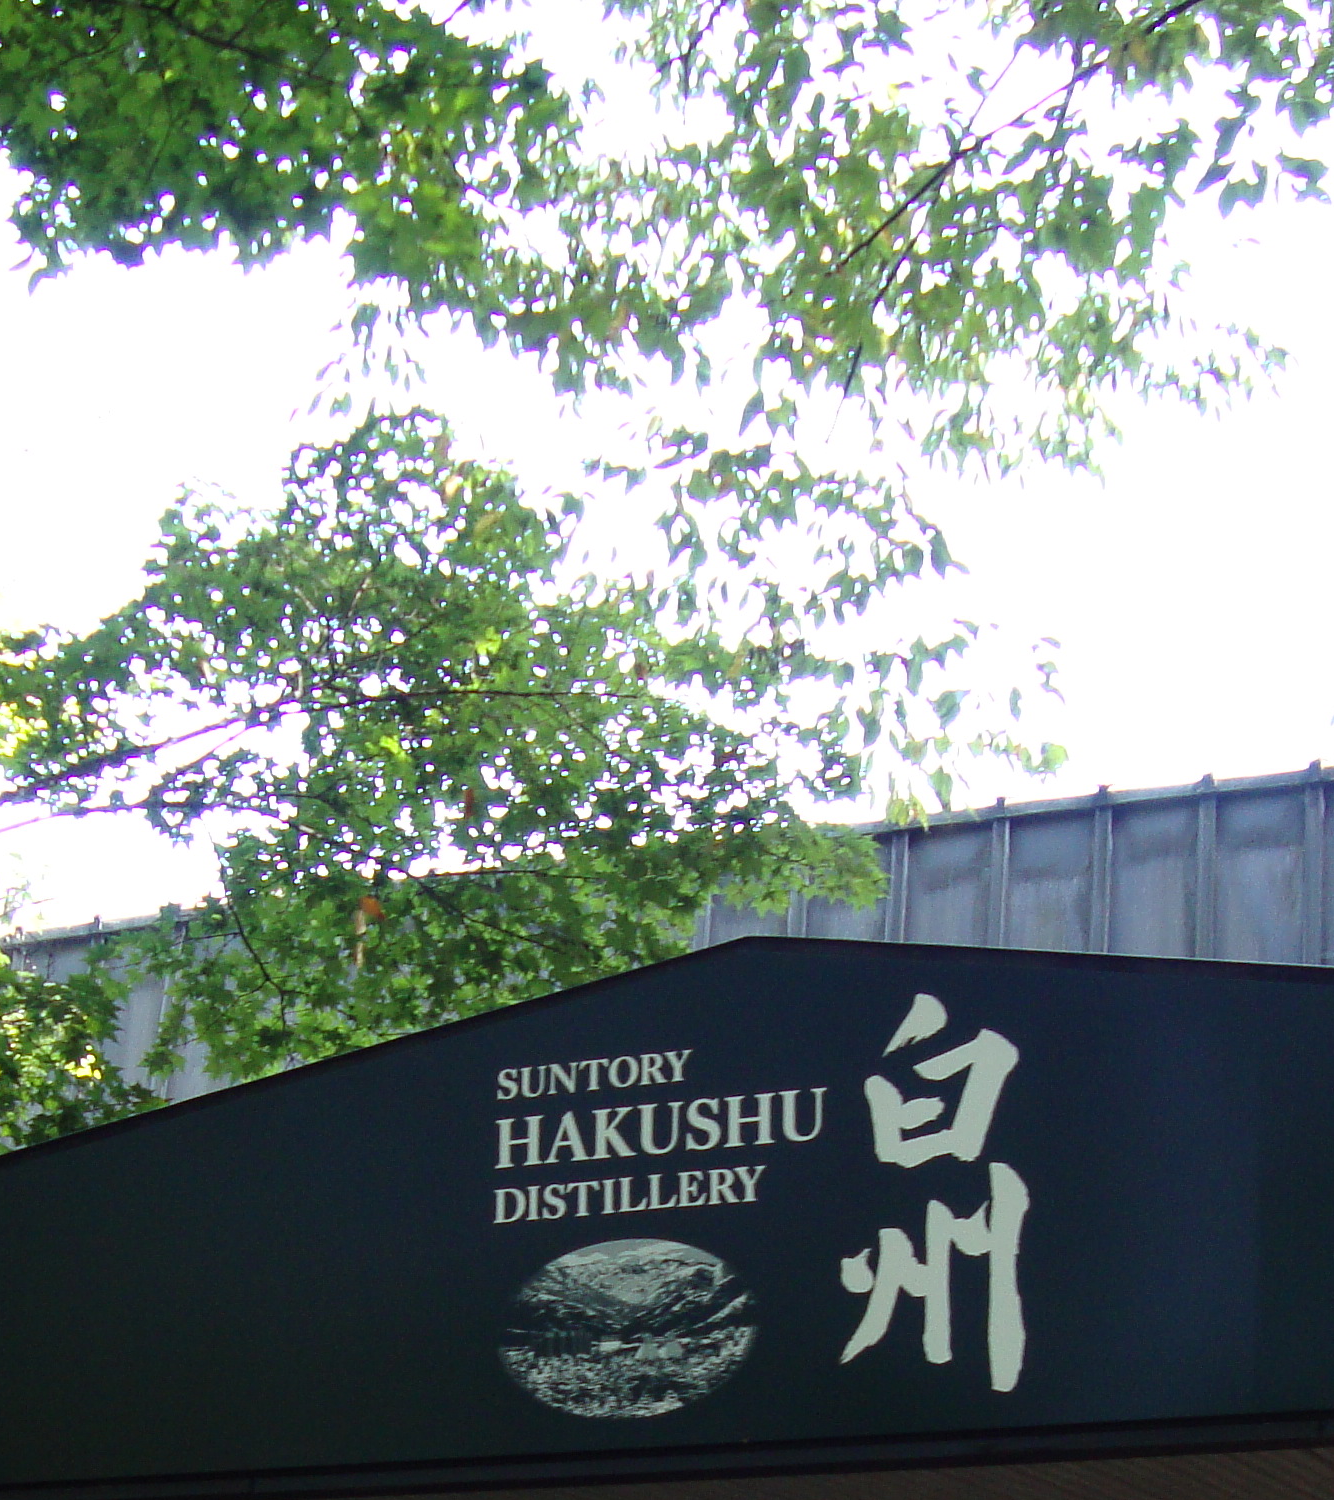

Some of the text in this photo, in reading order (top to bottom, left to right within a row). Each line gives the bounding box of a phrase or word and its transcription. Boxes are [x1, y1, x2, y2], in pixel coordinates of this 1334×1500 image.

[496, 1049, 693, 1100] SUNTORY
[494, 1087, 828, 1169] HAKUSHU
[493, 1165, 766, 1224] DISTILLERY
[840, 993, 1030, 1393] 白州
